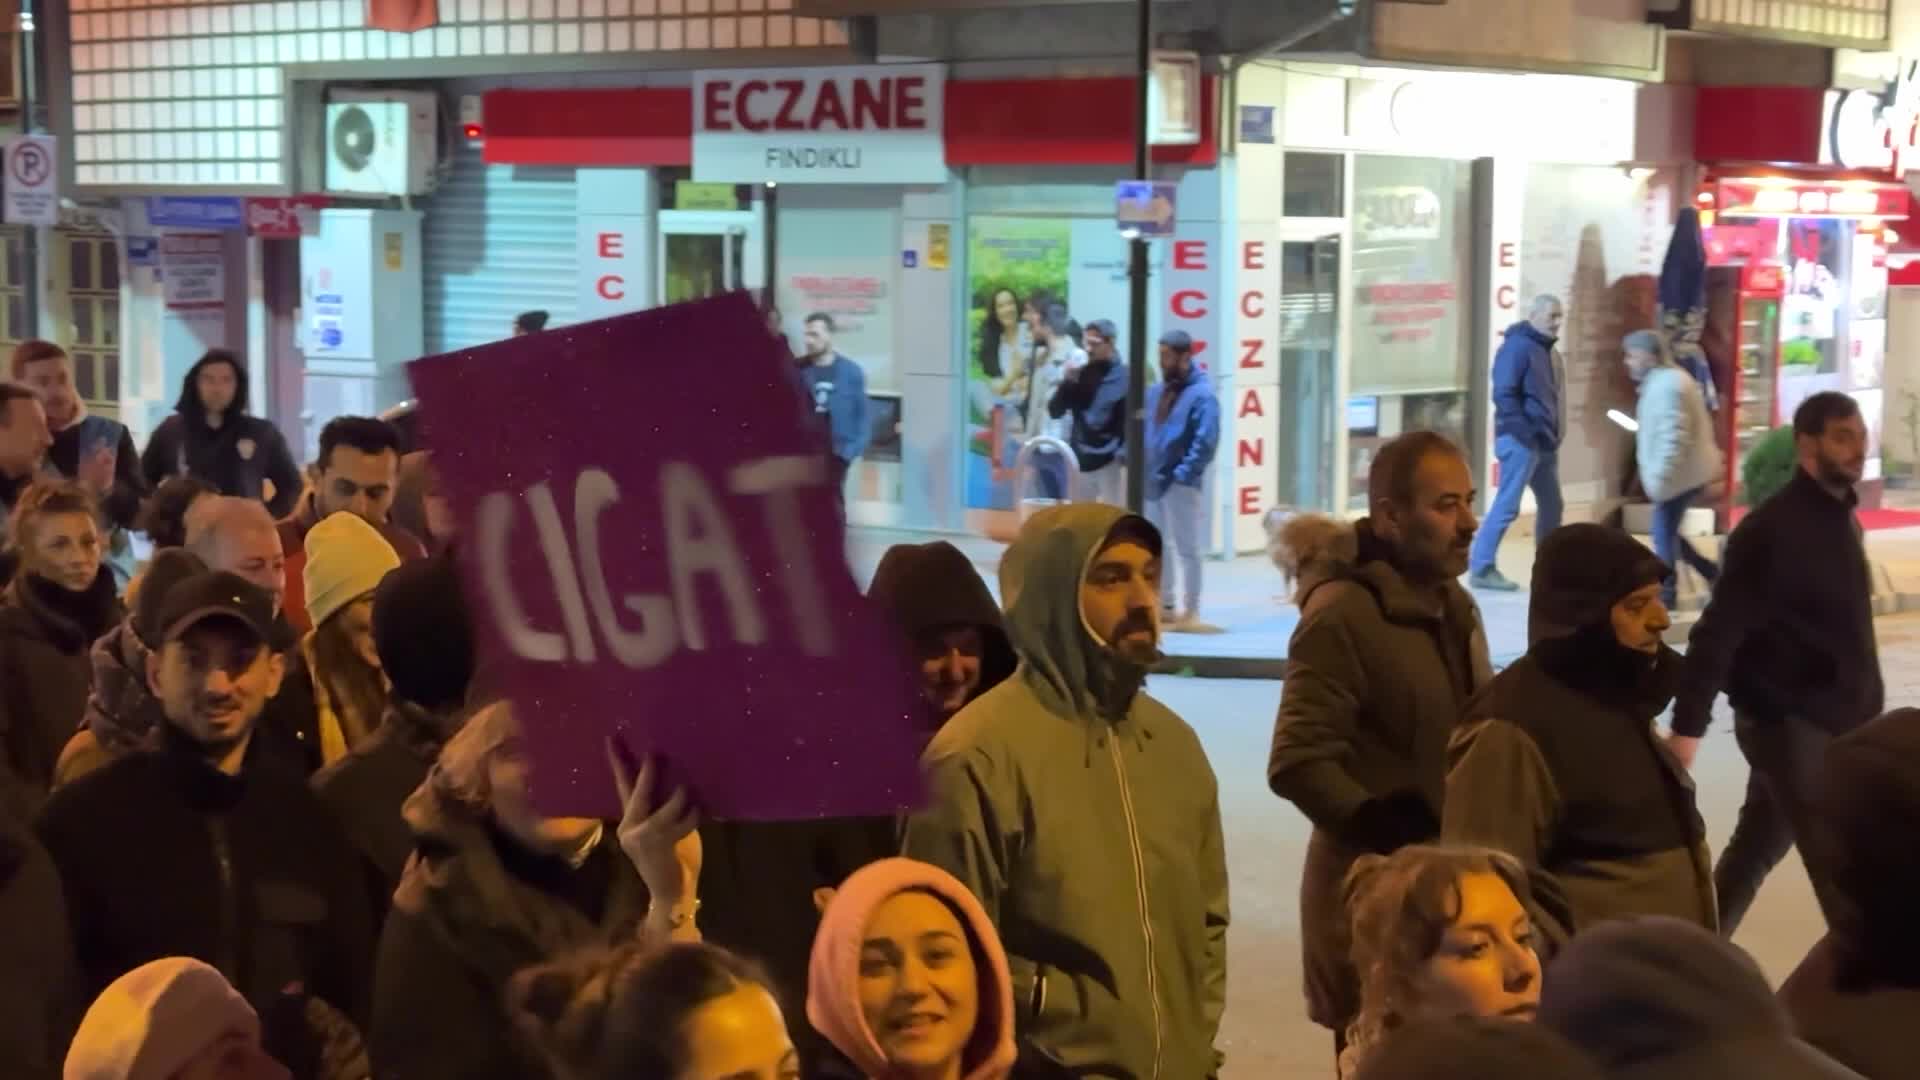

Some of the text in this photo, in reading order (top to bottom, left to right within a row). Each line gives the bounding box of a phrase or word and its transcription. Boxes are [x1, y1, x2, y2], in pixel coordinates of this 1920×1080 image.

[703, 76, 926, 132] ECZANE
[765, 147, 863, 169] FINDIKLI
[1237, 241, 1265, 515] ECZANE
